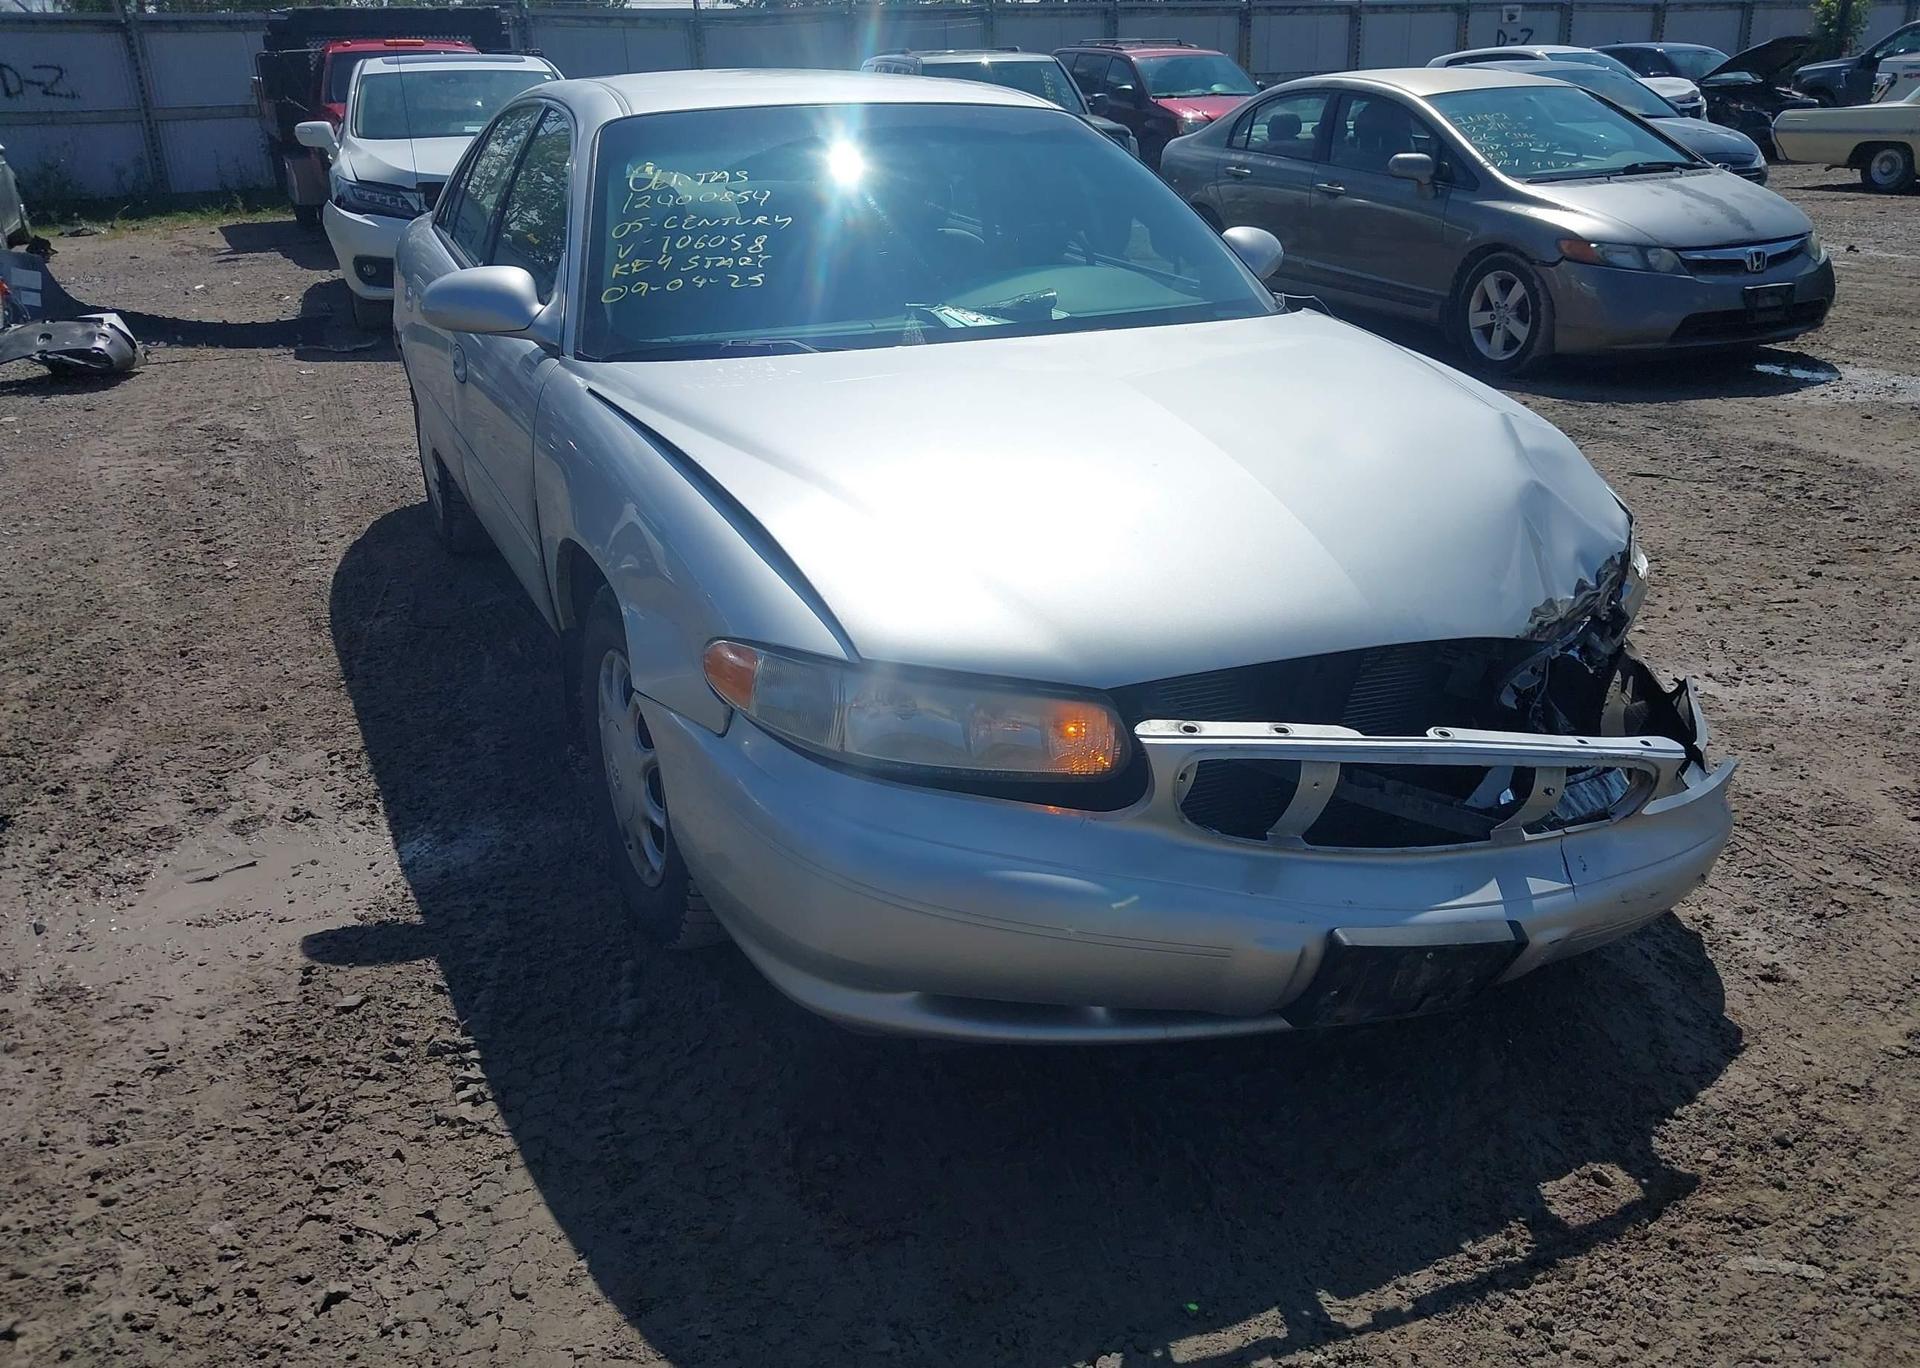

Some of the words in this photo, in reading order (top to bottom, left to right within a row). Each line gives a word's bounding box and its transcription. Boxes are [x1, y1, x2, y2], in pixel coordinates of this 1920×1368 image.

[622, 190, 771, 214] 12400854
[612, 254, 673, 279] KEY
[680, 254, 773, 272] START
